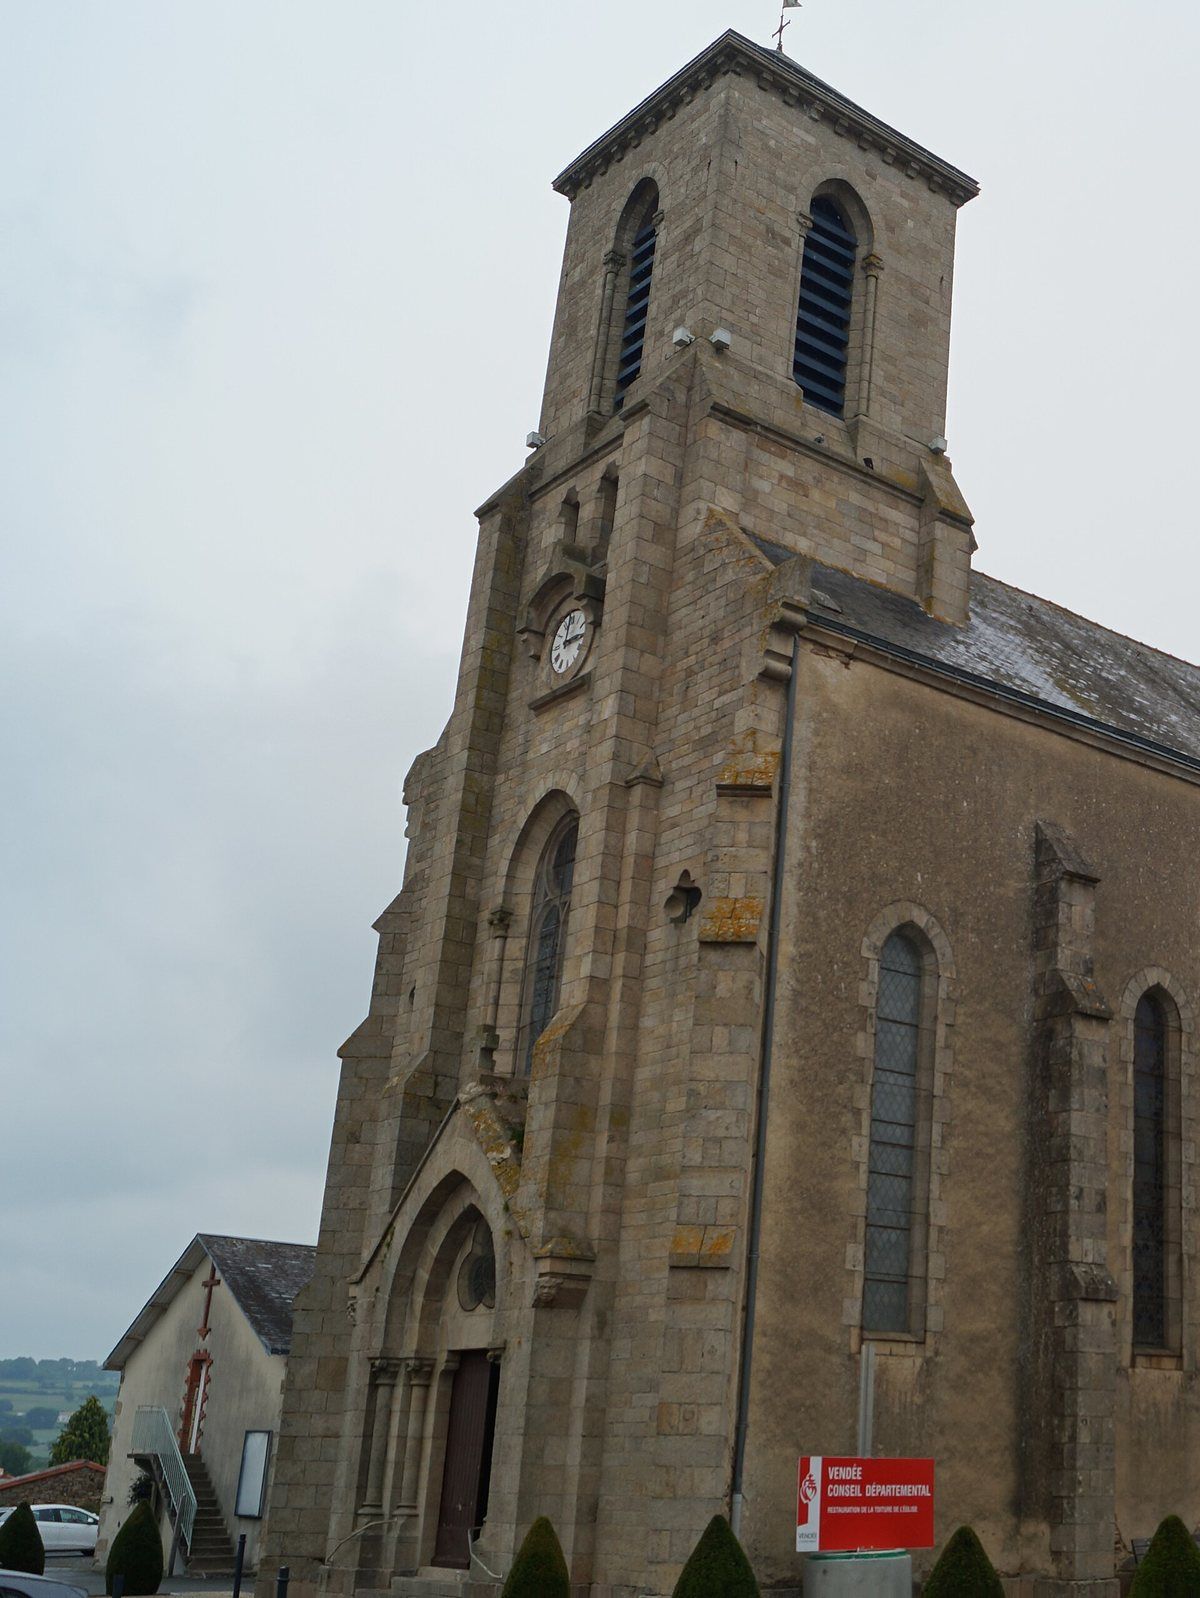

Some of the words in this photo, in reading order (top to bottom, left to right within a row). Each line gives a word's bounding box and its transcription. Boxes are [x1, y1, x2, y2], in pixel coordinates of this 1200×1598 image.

[827, 1463, 863, 1480] VENDÉE
[827, 1485, 862, 1497] CONSEIL
[865, 1482, 931, 1497] DÉPARTEMENTAL
[868, 1505, 874, 1513] LA
